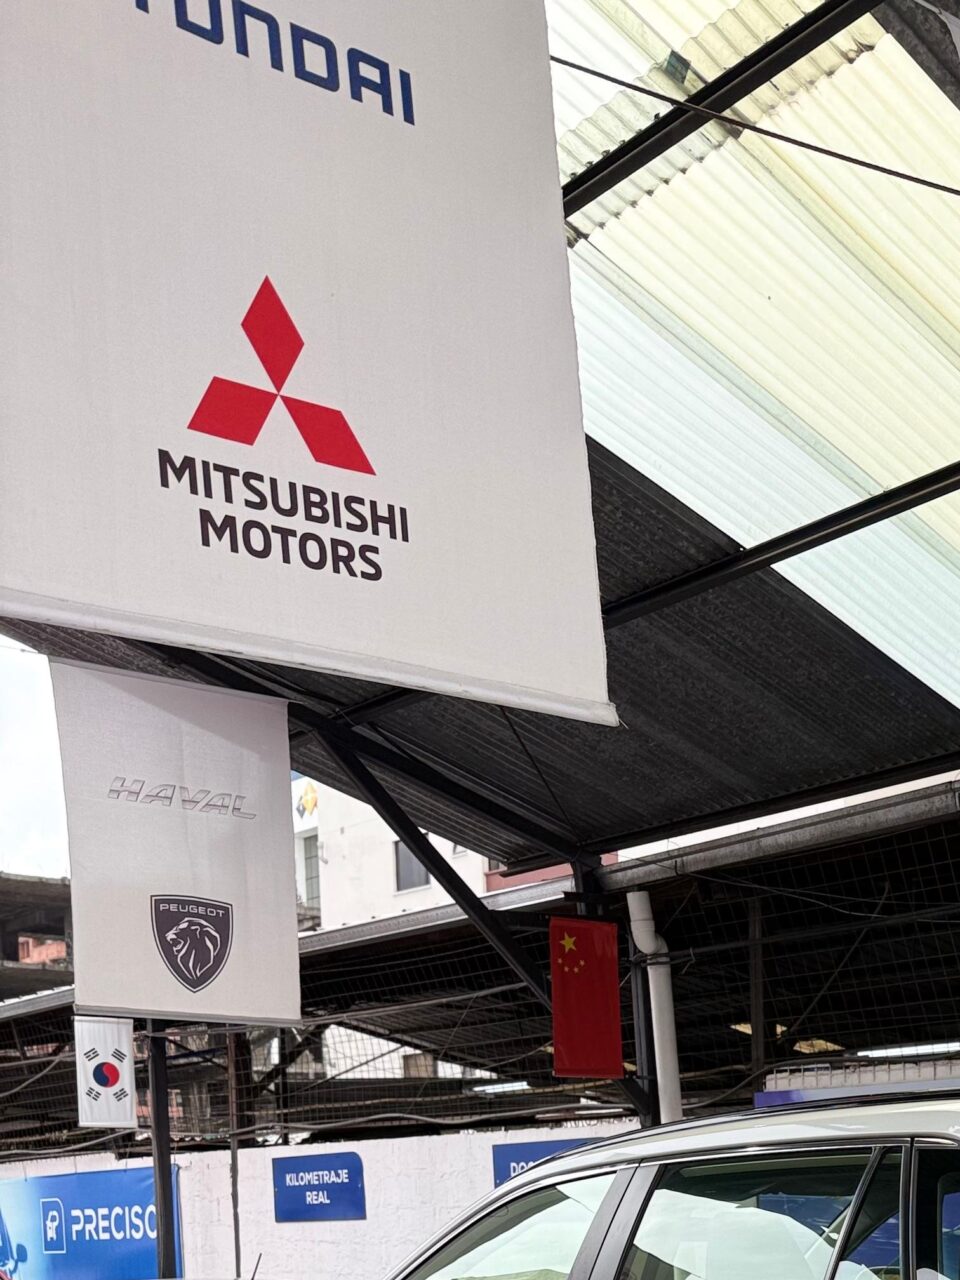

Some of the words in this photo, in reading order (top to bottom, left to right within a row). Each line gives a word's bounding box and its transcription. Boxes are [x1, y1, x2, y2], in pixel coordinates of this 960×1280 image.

[135, 0, 415, 126] UNDAI
[157, 448, 410, 543] MITSUBISHI
[199, 508, 383, 582] MOTORS
[107, 776, 257, 820] HAVAL
[159, 903, 225, 918] PEUGEOT
[285, 1169, 350, 1187] KILOMETRAJE
[305, 1190, 331, 1205] REAL
